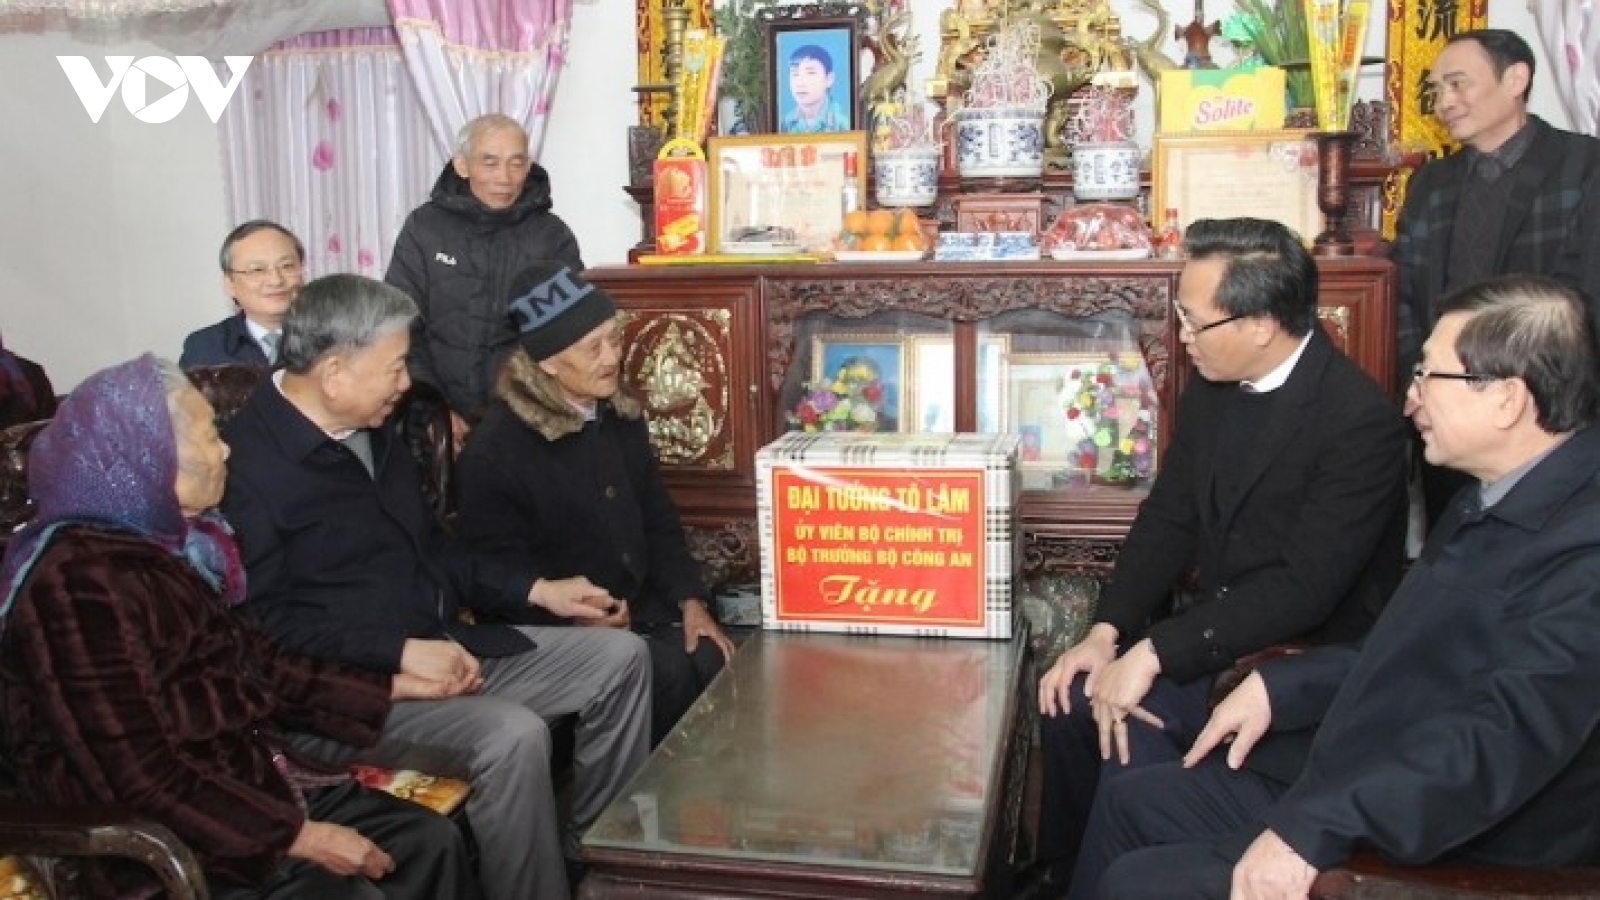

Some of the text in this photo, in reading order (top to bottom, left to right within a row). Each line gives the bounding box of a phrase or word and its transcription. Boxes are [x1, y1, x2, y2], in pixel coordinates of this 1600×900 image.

[1195, 98, 1253, 124] Solite
[788, 485, 819, 515] ĐẠI
[896, 484, 920, 512] TÔ
[926, 485, 969, 513] LÂM
[819, 522, 853, 543] VIÊN
[859, 525, 880, 544] BỘ
[884, 525, 933, 543] CHÍNH
[938, 527, 963, 546] TRỊ
[787, 546, 806, 566] BỘ
[876, 547, 898, 569] BỘ
[902, 549, 945, 567] CÔNG
[949, 551, 972, 567] AN
[819, 574, 936, 612] Tặng
